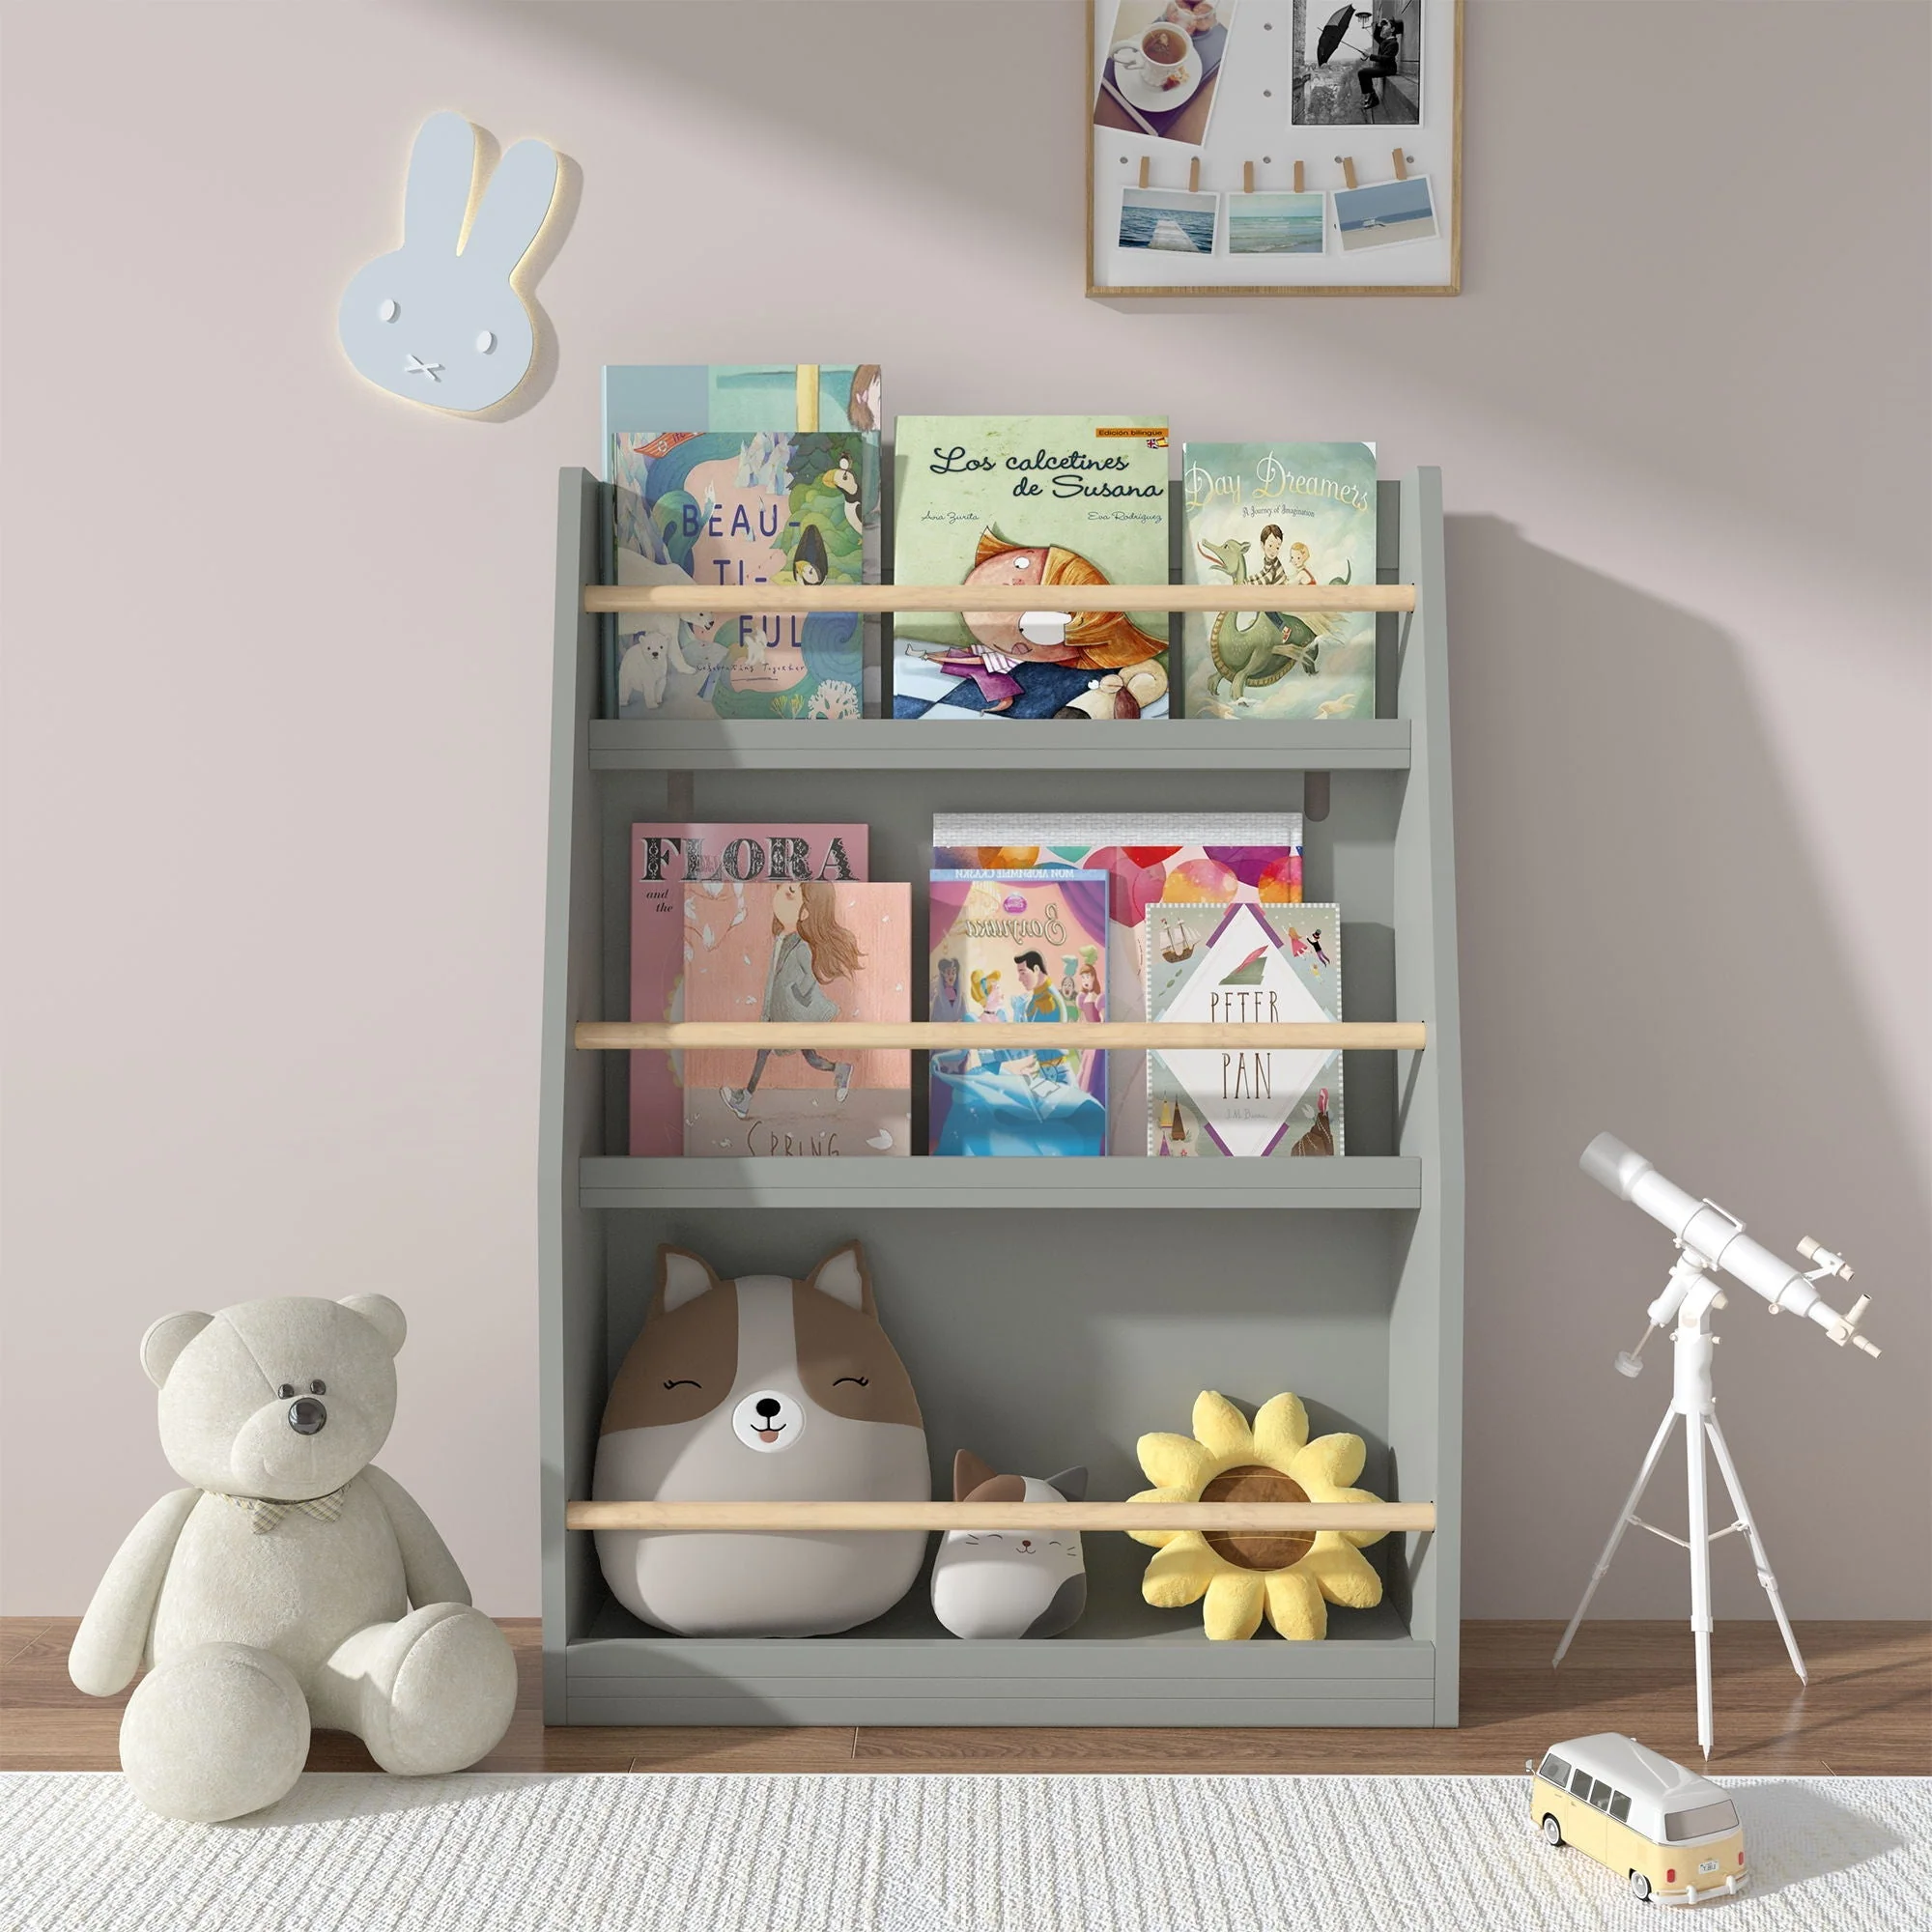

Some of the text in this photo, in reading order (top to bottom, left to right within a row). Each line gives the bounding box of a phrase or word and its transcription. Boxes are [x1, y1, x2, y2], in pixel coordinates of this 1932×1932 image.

[929, 445, 1129, 474] Los calcetines
[1012, 474, 1164, 497] de Susana
[1184, 448, 1369, 513] Day Dreamers
[921, 510, 980, 524] Ana Zurita
[1088, 511, 1110, 521] Eva
[739, 614, 803, 648] FUL
[639, 837, 861, 883] FLORA
[645, 889, 668, 899] and
[656, 901, 673, 913] the
[1222, 1052, 1271, 1099] PAN
